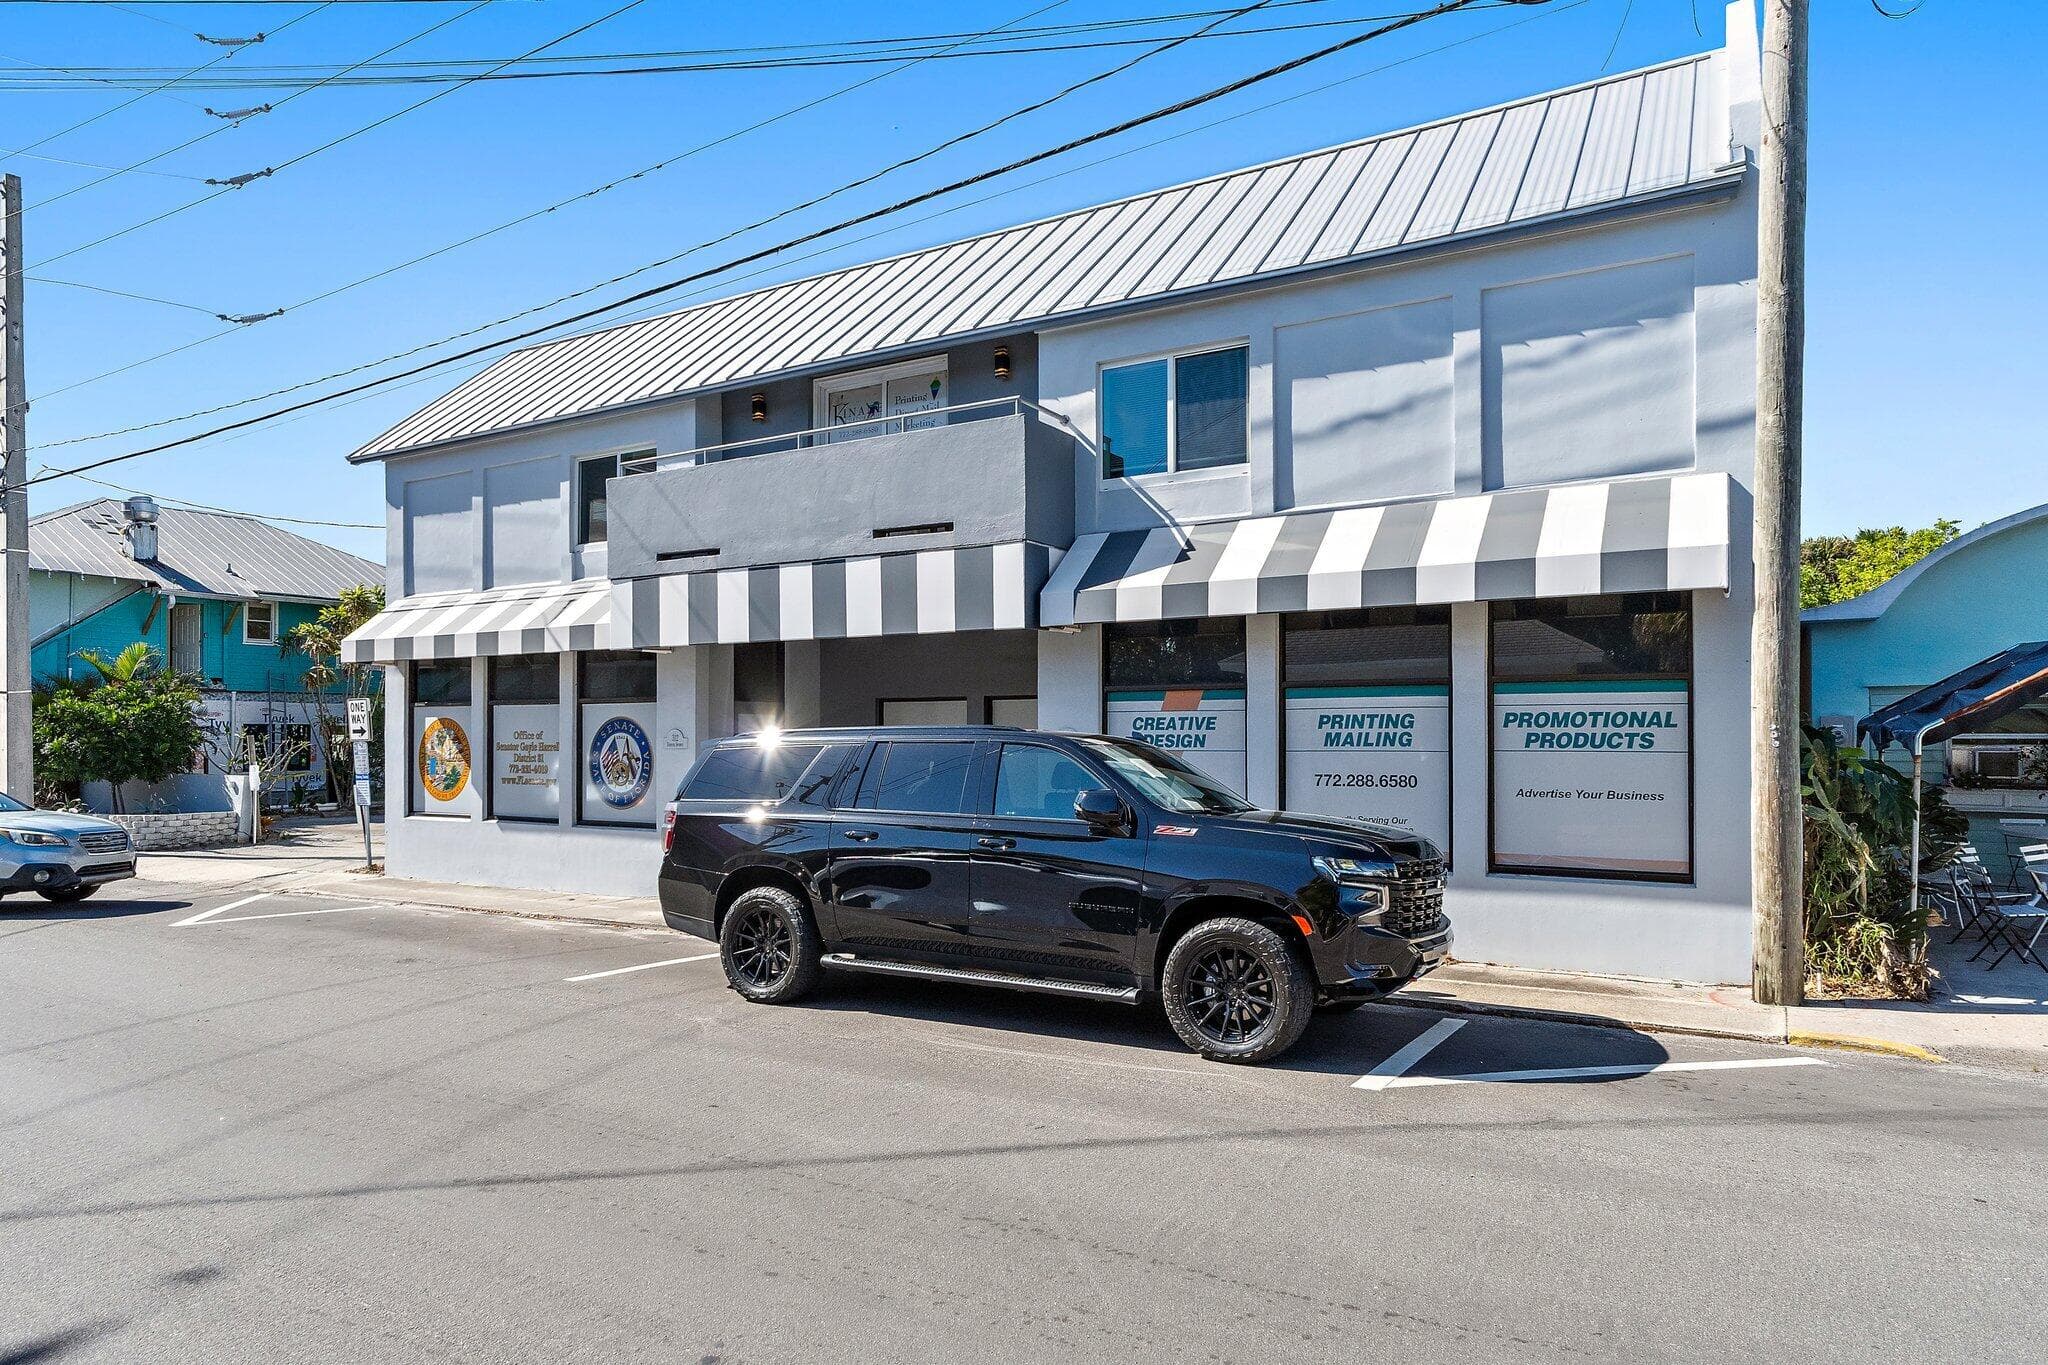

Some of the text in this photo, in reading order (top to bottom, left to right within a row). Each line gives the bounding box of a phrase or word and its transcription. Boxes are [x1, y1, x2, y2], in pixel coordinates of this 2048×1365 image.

[895, 393, 928, 405] Printing
[895, 418, 936, 431] Mrketing
[350, 702, 365, 712] ONE
[351, 714, 366, 724] WAY
[1132, 716, 1217, 731] CREATIVE
[1317, 713, 1415, 730] PRINTING
[1502, 711, 1678, 728] PROMOTIONAL
[513, 730, 544, 740] Office of
[600, 721, 641, 739] SENATE
[1143, 733, 1207, 748] DESIGN
[1323, 731, 1413, 748] MAILING
[1524, 731, 1655, 749] PRODUCTS
[1314, 773, 1418, 788] 772.288.6580
[1515, 788, 1665, 801] Advertise Your Business
[1391, 816, 1409, 825] Our
